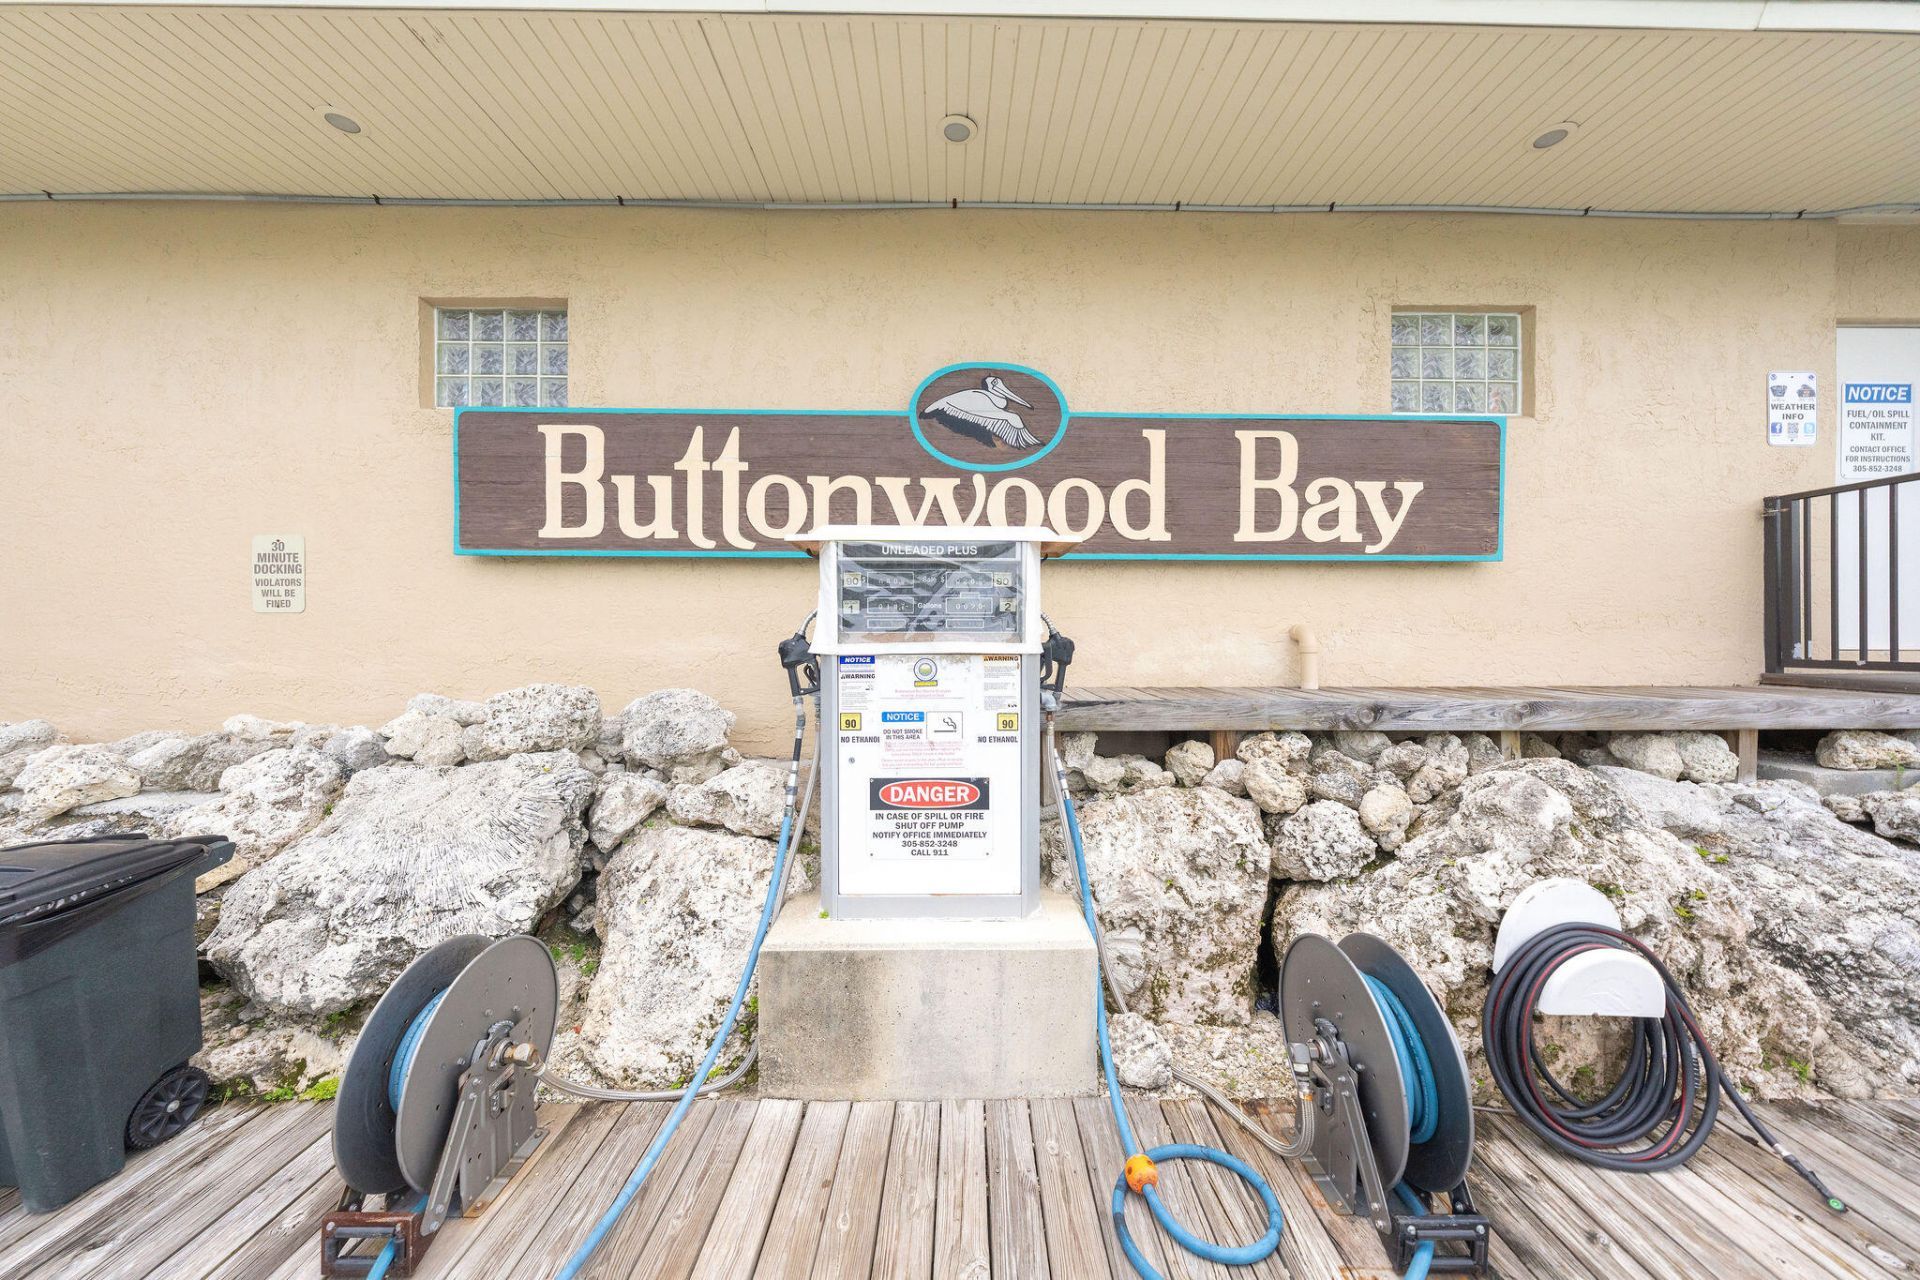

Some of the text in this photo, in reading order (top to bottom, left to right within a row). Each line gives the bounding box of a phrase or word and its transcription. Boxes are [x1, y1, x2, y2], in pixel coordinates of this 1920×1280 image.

[1848, 386, 1908, 401] NOTICE
[1771, 403, 1815, 411] WEATHER
[1887, 410, 1910, 418] SPILL
[1849, 422, 1908, 430] CONTAINMENT
[1870, 433, 1886, 441] KIT.
[1852, 465, 1903, 473] 305-852-3248
[537, 424, 1424, 554] Buttonwood Bay
[271, 541, 285, 551] 30
[882, 545, 978, 555] UNLEADED PLUS
[257, 553, 299, 563] MINUTE
[254, 564, 303, 575] DOCKING
[255, 578, 302, 587] VIOLATORS
[846, 577, 859, 586] 90
[996, 577, 1009, 586] 90
[261, 589, 296, 598] WILL BE
[266, 600, 292, 608] FINED
[1004, 603, 1012, 612] 2
[886, 712, 920, 721] NOTICE
[845, 719, 857, 729] 90
[1002, 719, 1014, 729] 90
[890, 787, 970, 802] DANGER
[901, 840, 958, 848] 305-852-3248
[910, 849, 949, 857] CALL 911
